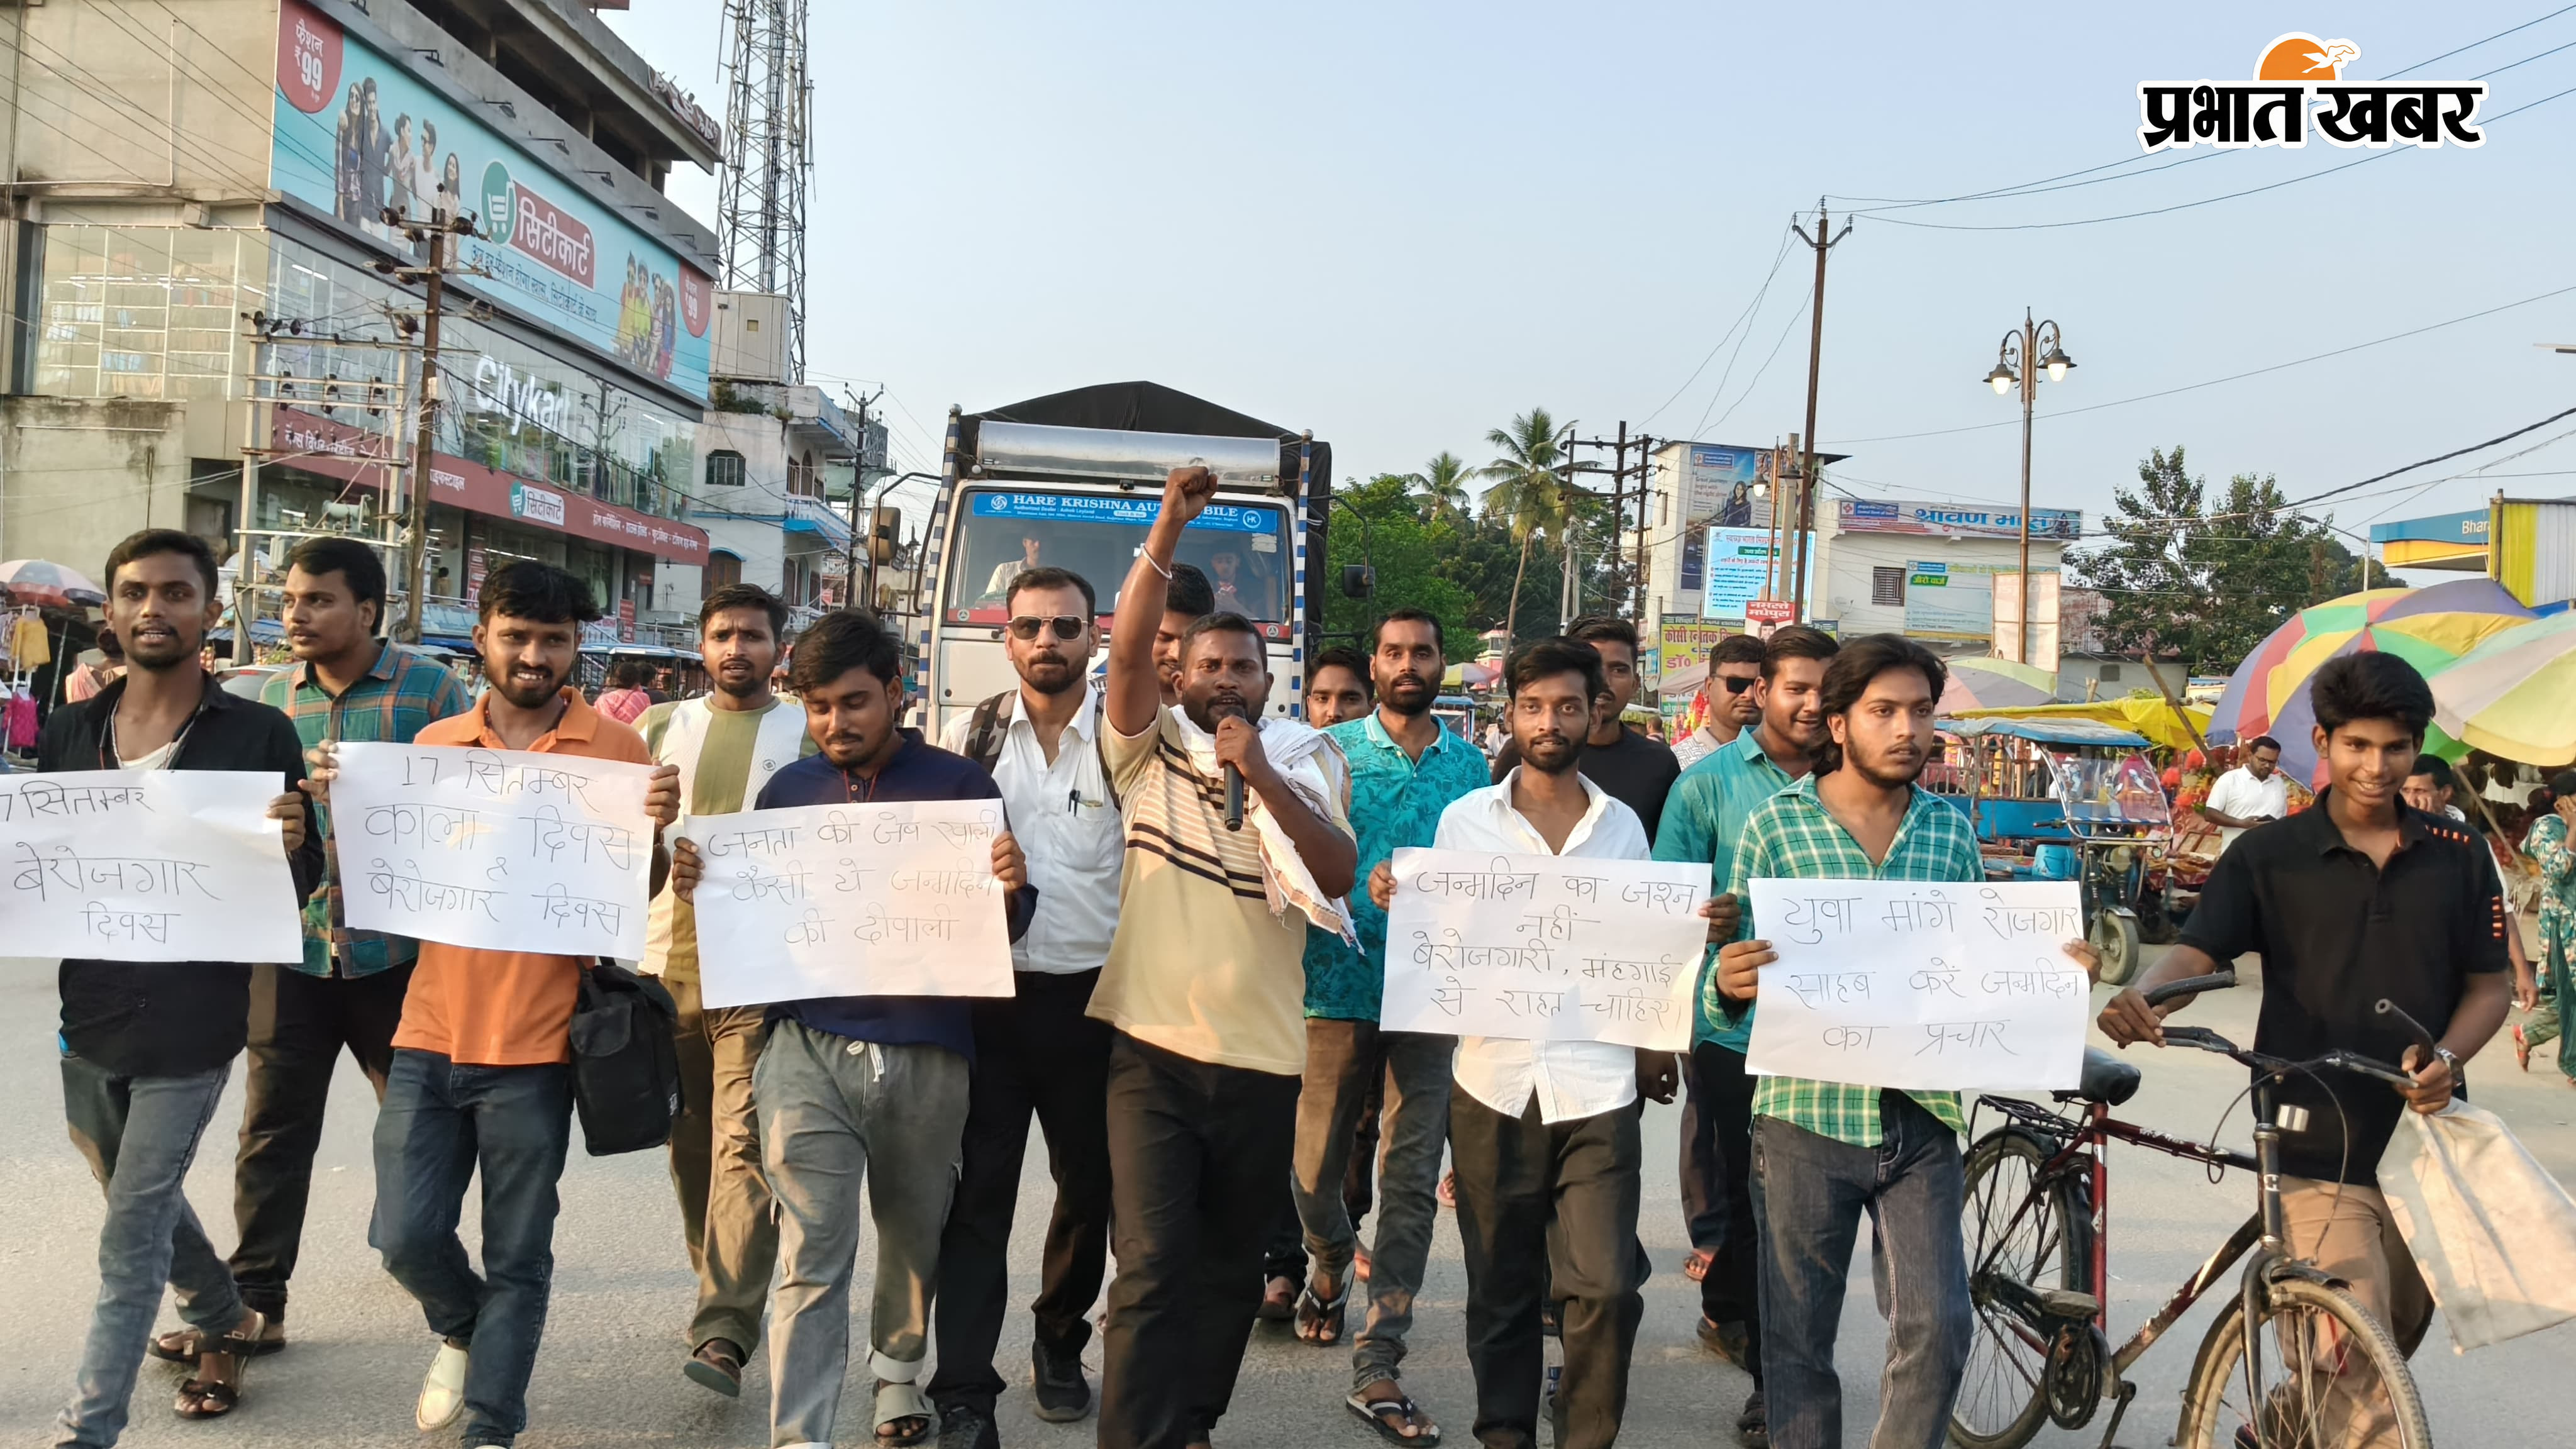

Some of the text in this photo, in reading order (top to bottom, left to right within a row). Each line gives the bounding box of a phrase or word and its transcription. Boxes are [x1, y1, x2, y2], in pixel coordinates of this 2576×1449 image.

[296, 18, 324, 57] फैशन
[518, 196, 590, 275] सिटीकार्ट
[516, 263, 531, 291] होगा
[430, 468, 465, 492] ाइफस्टाइल
[527, 491, 563, 521] सिटीकार्ट
[1013, 495, 1057, 506] HARE
[1061, 497, 1132, 511] KRISHNA
[1915, 508, 1989, 526] श्रावण
[1748, 608, 1790, 618] मधेपुरा
[1750, 601, 1789, 609] नमस्ते
[1664, 626, 1687, 642] कोसी
[20, 780, 156, 818] सितम्बर
[402, 749, 601, 813] 17 सितम्बर
[365, 804, 634, 870] काला दिवस
[708, 809, 997, 858] जनता की जेब खाली
[14, 842, 223, 902] बेरोजगार
[732, 857, 994, 906] कैसी ये जन्मदिन
[1417, 856, 1697, 914] जन्मदिन का जश्न
[366, 858, 630, 936] बेरोजगार दिवस
[1782, 887, 2080, 944] युवा मांगे रोजगार
[79, 901, 181, 944] दिवस
[784, 908, 835, 947] की
[1517, 904, 1601, 941] नहीं
[1582, 953, 1682, 989] मंहगाई
[1785, 957, 2084, 1010] साहब करें जन्मदिन
[1431, 976, 1477, 1016] से
[1496, 990, 1565, 1018] राहत
[1823, 1019, 2018, 1057] का प्रचार
